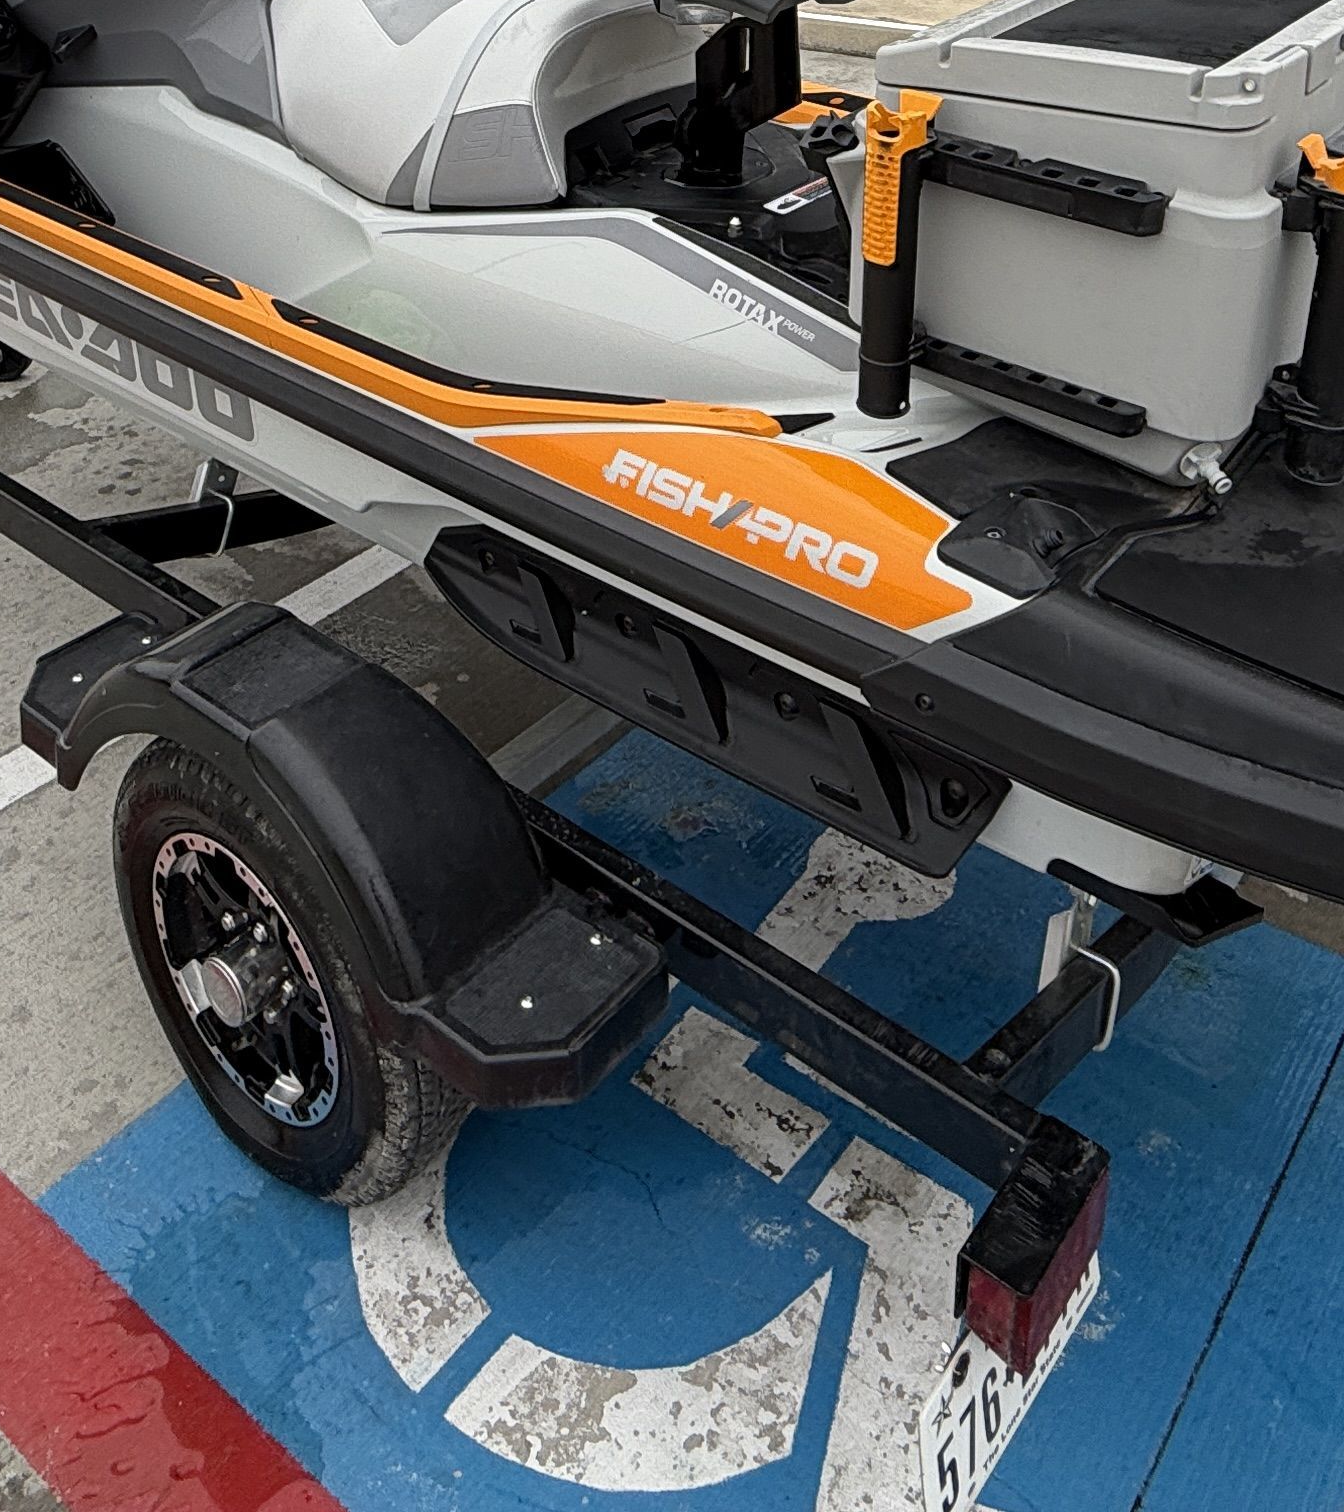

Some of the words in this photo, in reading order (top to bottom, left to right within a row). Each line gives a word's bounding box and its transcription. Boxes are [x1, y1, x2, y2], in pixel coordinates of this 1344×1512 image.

[709, 278, 784, 335] ROTAX
[782, 318, 816, 342] POWER
[1001, 1407, 1021, 1443] Lone
[1022, 1376, 1040, 1406] Star
